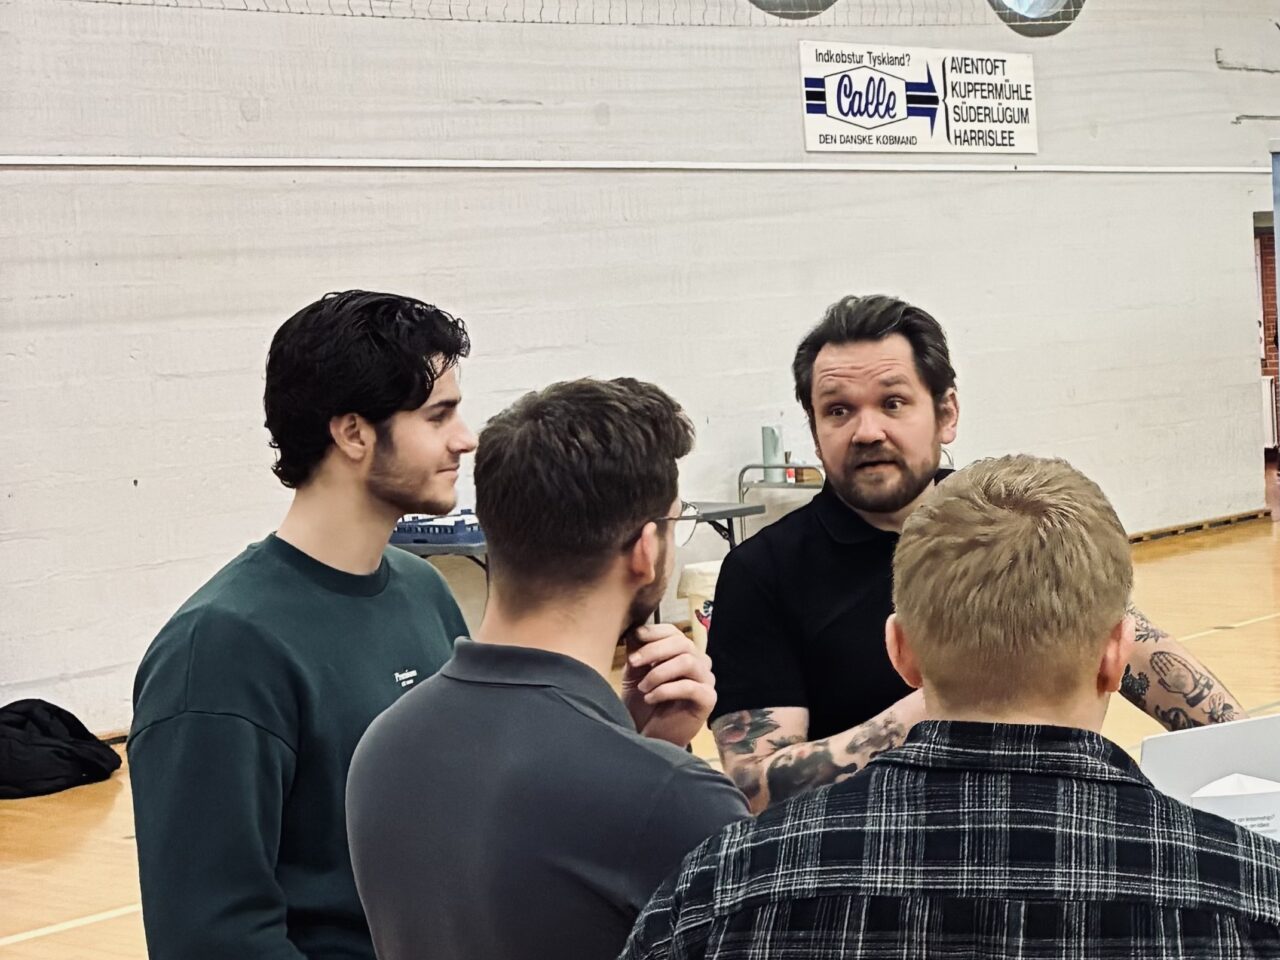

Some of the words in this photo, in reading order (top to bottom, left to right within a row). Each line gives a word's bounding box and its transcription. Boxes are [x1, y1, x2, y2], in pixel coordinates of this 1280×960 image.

[815, 49, 865, 65] Indkøbstur
[866, 51, 911, 68] Tyskland?
[950, 57, 1007, 76] AVENTOFT
[836, 73, 897, 119] Calle
[951, 79, 1033, 101] KUPFERMÜHLE
[953, 102, 1030, 124] SÜDERLÜGUM
[818, 134, 837, 145] DEN
[839, 134, 874, 146] DANSKE
[876, 135, 918, 146] KØBMAND
[954, 129, 1016, 147] HARRISLEE
